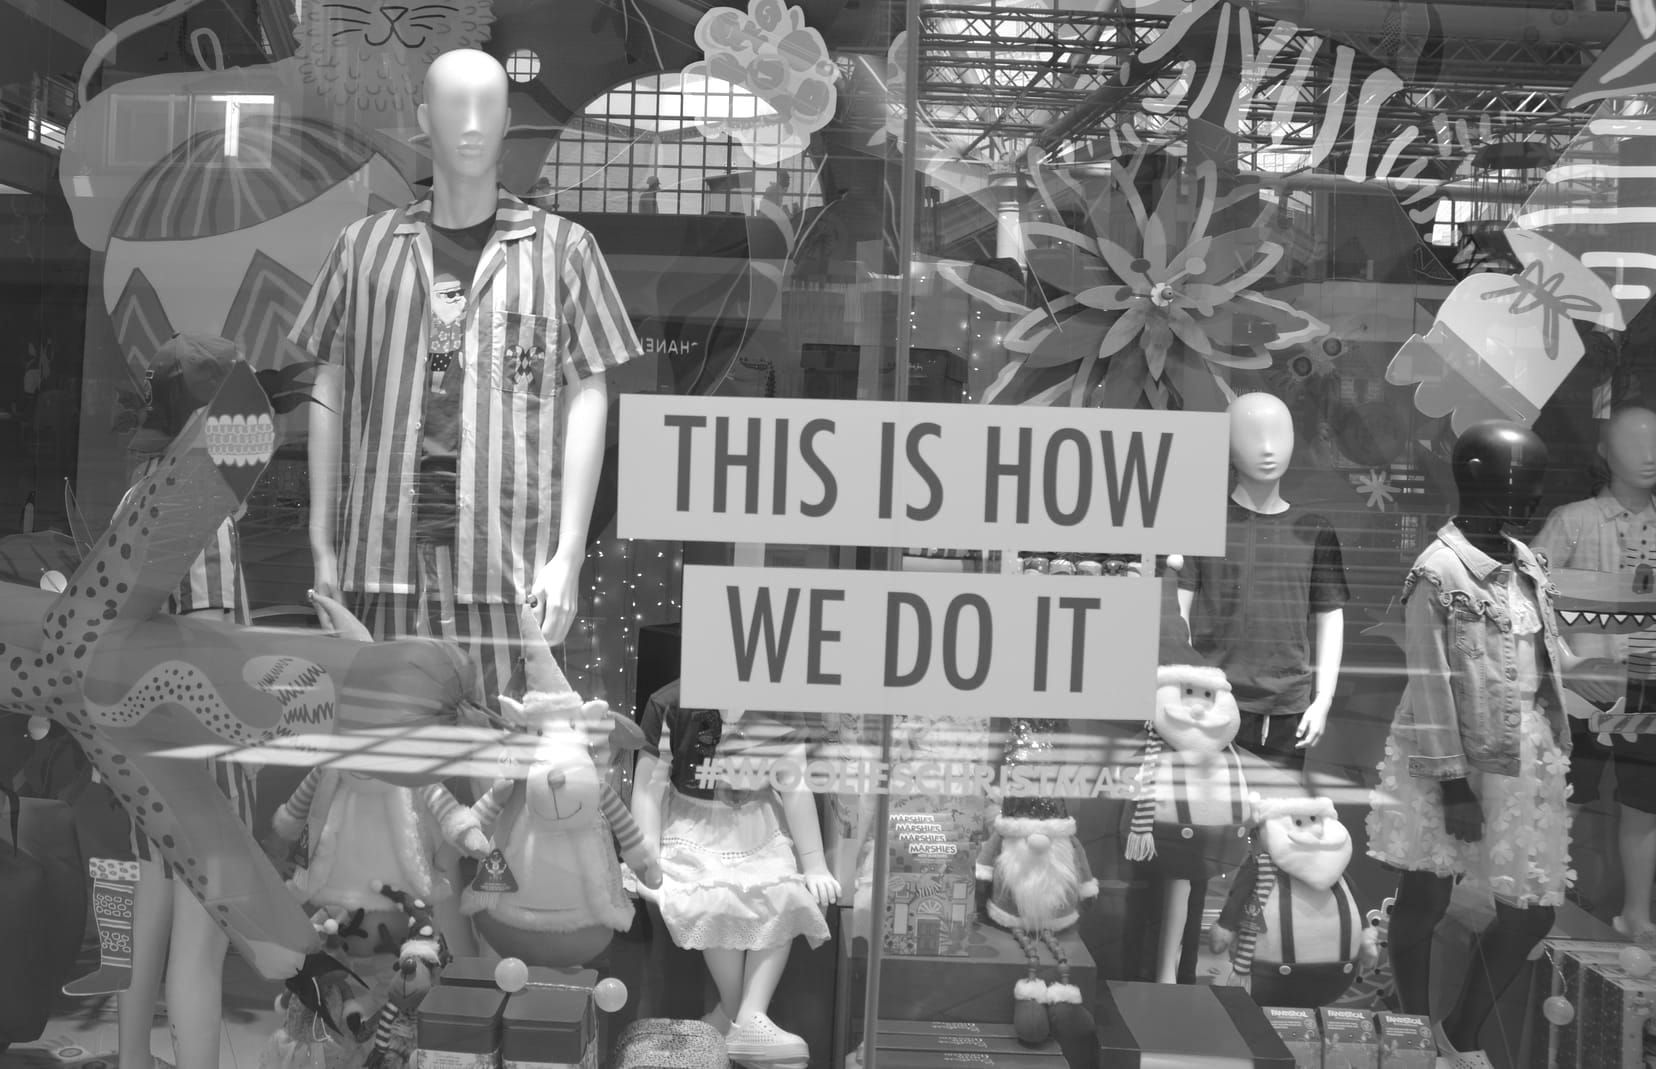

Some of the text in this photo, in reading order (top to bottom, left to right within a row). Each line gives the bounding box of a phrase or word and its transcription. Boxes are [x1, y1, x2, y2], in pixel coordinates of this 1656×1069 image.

[664, 415, 1174, 528] THIS IS HOW
[726, 586, 1102, 693] WE DO IT
[695, 757, 1141, 801] #WOOLIESCHRISTMAS
[909, 844, 957, 854] MARSHIES
